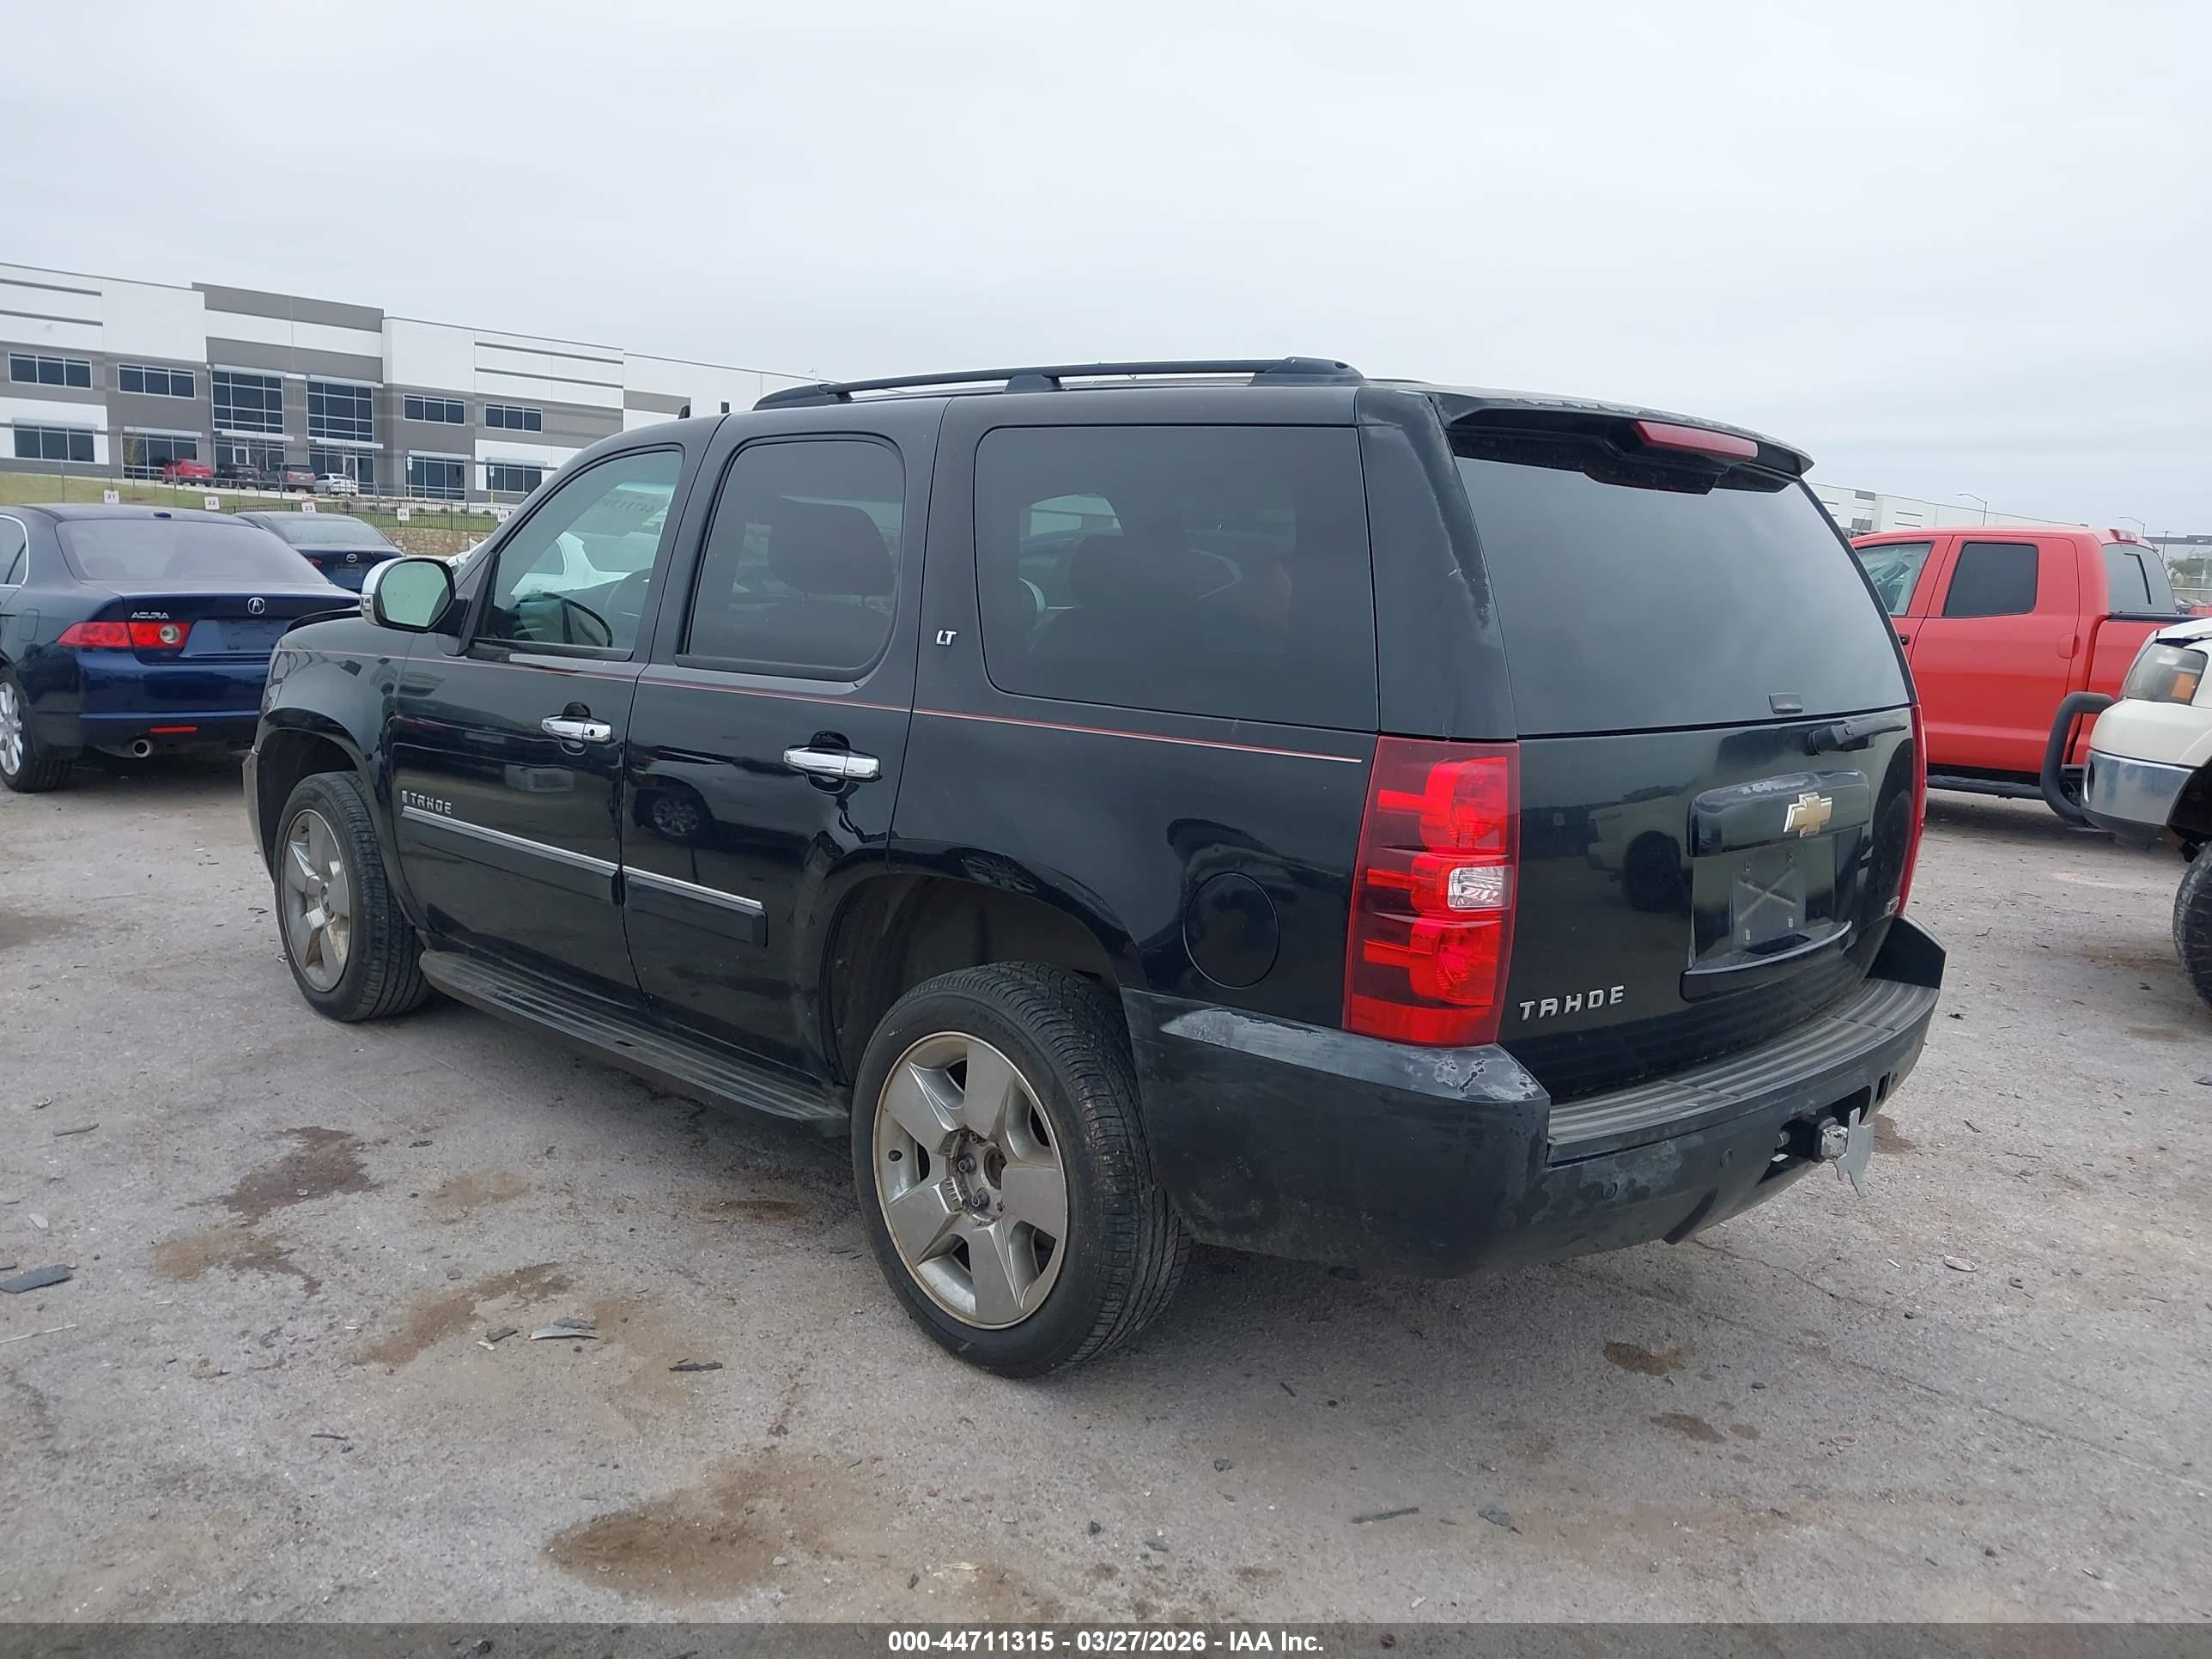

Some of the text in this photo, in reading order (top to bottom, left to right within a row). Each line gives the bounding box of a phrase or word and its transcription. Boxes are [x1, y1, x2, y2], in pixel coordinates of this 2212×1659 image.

[936, 629, 957, 646] LT
[410, 792, 452, 815] TAHOE
[1519, 985, 1625, 1021] TAHOE
